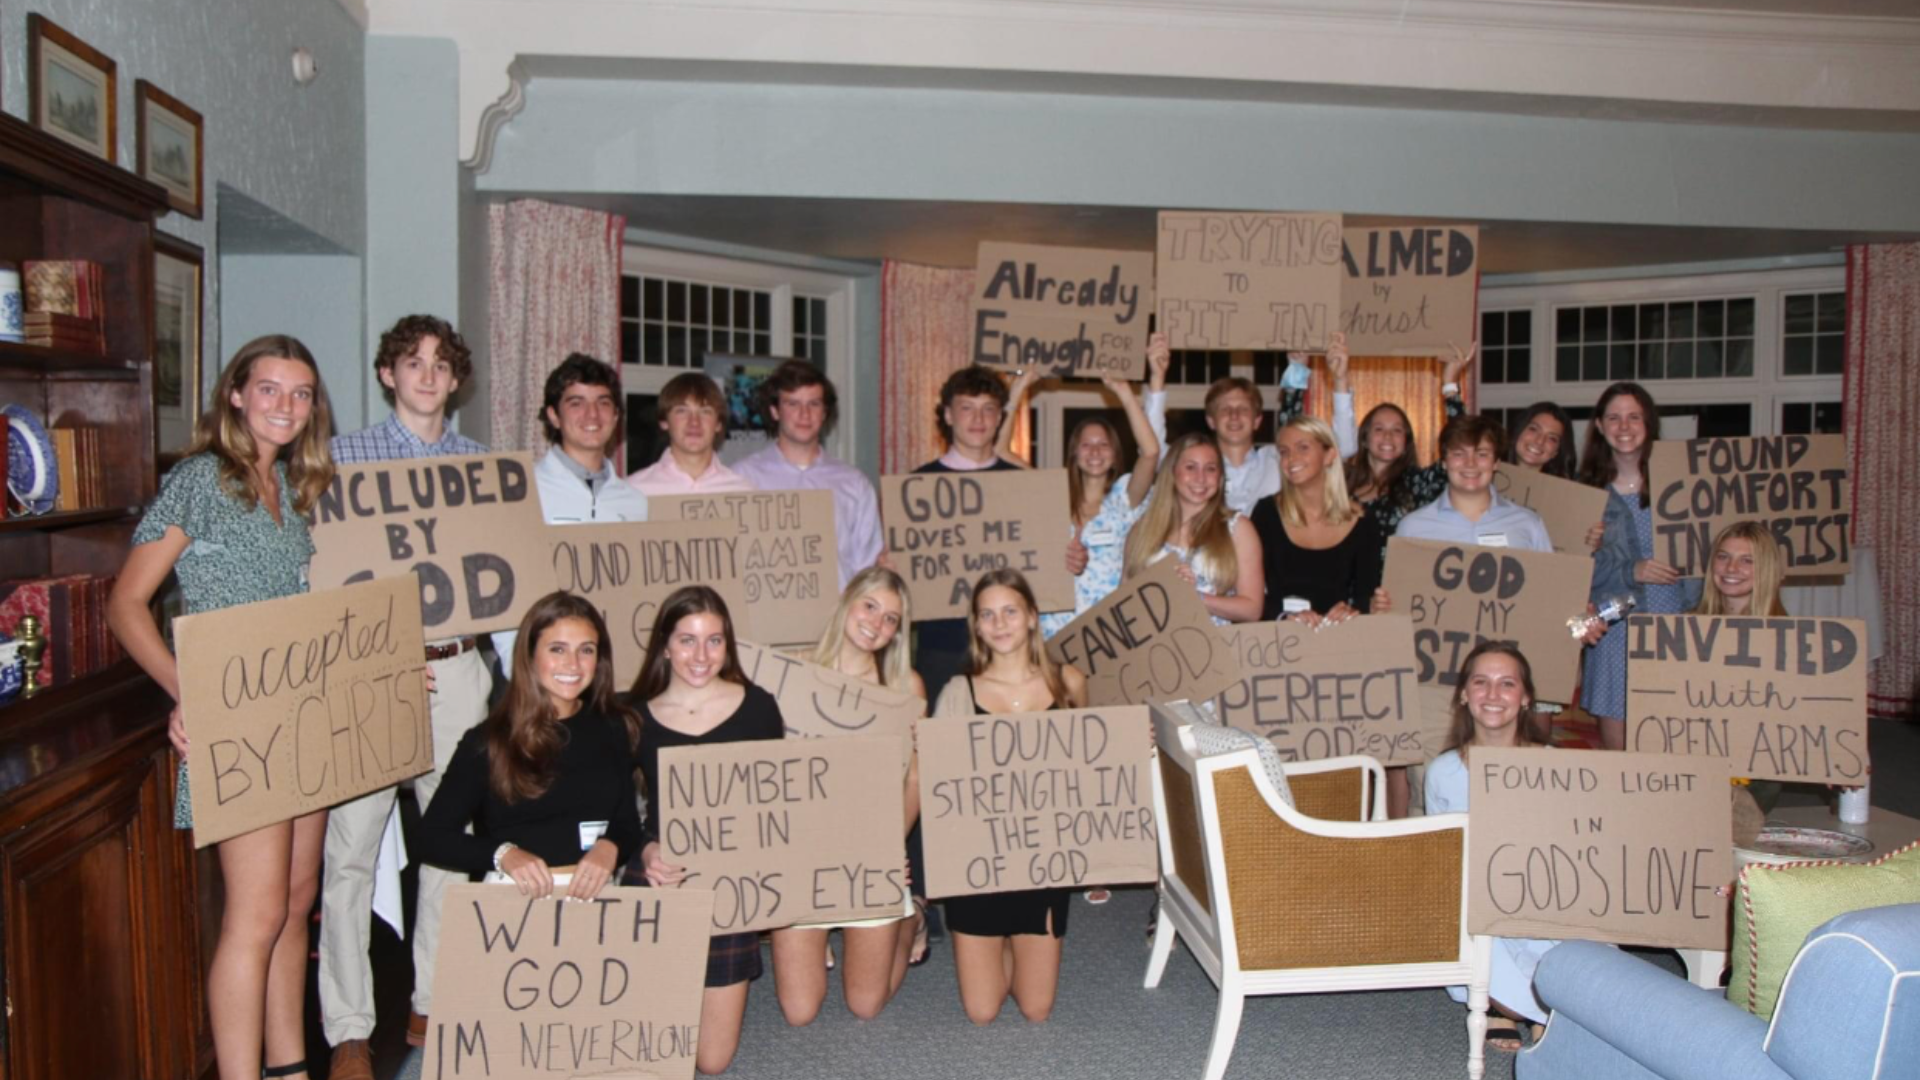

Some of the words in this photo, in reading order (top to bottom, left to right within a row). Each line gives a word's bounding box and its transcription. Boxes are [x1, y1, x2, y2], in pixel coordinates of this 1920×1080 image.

[1161, 215, 1343, 267] TRYING
[982, 260, 1140, 325] Already
[1223, 272, 1250, 293] TO
[1372, 281, 1391, 304] by
[973, 309, 1095, 377] Enough
[1101, 333, 1134, 350] FOR
[1160, 297, 1239, 349] FIT
[1266, 301, 1328, 350] IN
[1097, 353, 1132, 372] GOD
[1686, 435, 1809, 475] FOUND
[902, 476, 983, 522] GOD
[1656, 469, 1846, 521] COMFORT
[385, 517, 438, 561] BY
[641, 536, 738, 586] IDENTITY
[890, 523, 967, 552] LOVES
[983, 520, 1022, 543] ME
[1657, 521, 1711, 577] IN
[1761, 513, 1849, 568] RIST
[343, 552, 515, 627] OD
[744, 571, 819, 604] OWN
[911, 553, 951, 581] FOR
[963, 553, 1008, 571] WHO
[1020, 551, 1038, 571] I
[949, 578, 973, 605] A
[1433, 547, 1525, 599] GOD
[1411, 594, 1447, 625] BY
[1476, 600, 1516, 634] MY
[222, 594, 399, 710] accepted
[1119, 626, 1213, 705] GOD
[1414, 629, 1520, 686] SI
[1629, 616, 1858, 676] INVITED
[1219, 667, 1414, 727] PERFECT
[209, 724, 282, 806] BY
[295, 666, 429, 797] CHRIST
[967, 714, 1108, 772] FOUND
[1266, 724, 1368, 762] GOD'
[1367, 731, 1422, 761] eyes
[1635, 715, 1730, 757] OPEN
[1747, 721, 1863, 779] ARMS
[668, 756, 829, 809] NUMBER
[932, 767, 1082, 818] STRENGTH
[1094, 764, 1137, 807] IN
[1484, 763, 1598, 793] FOUND
[1621, 771, 1697, 794] LIGHT
[666, 815, 738, 856] ONE
[757, 810, 790, 849] IN
[983, 816, 1040, 855] THE
[1054, 807, 1156, 847] POWER
[1573, 817, 1602, 834] IN
[812, 863, 906, 910] EYES
[966, 856, 1006, 889] OF
[1029, 850, 1088, 885] GOD
[1487, 843, 1610, 917] GOD'S
[1622, 845, 1715, 919] LOVE
[472, 898, 660, 953] WITH
[503, 958, 628, 1011] GOD
[437, 1020, 489, 1080] IM
